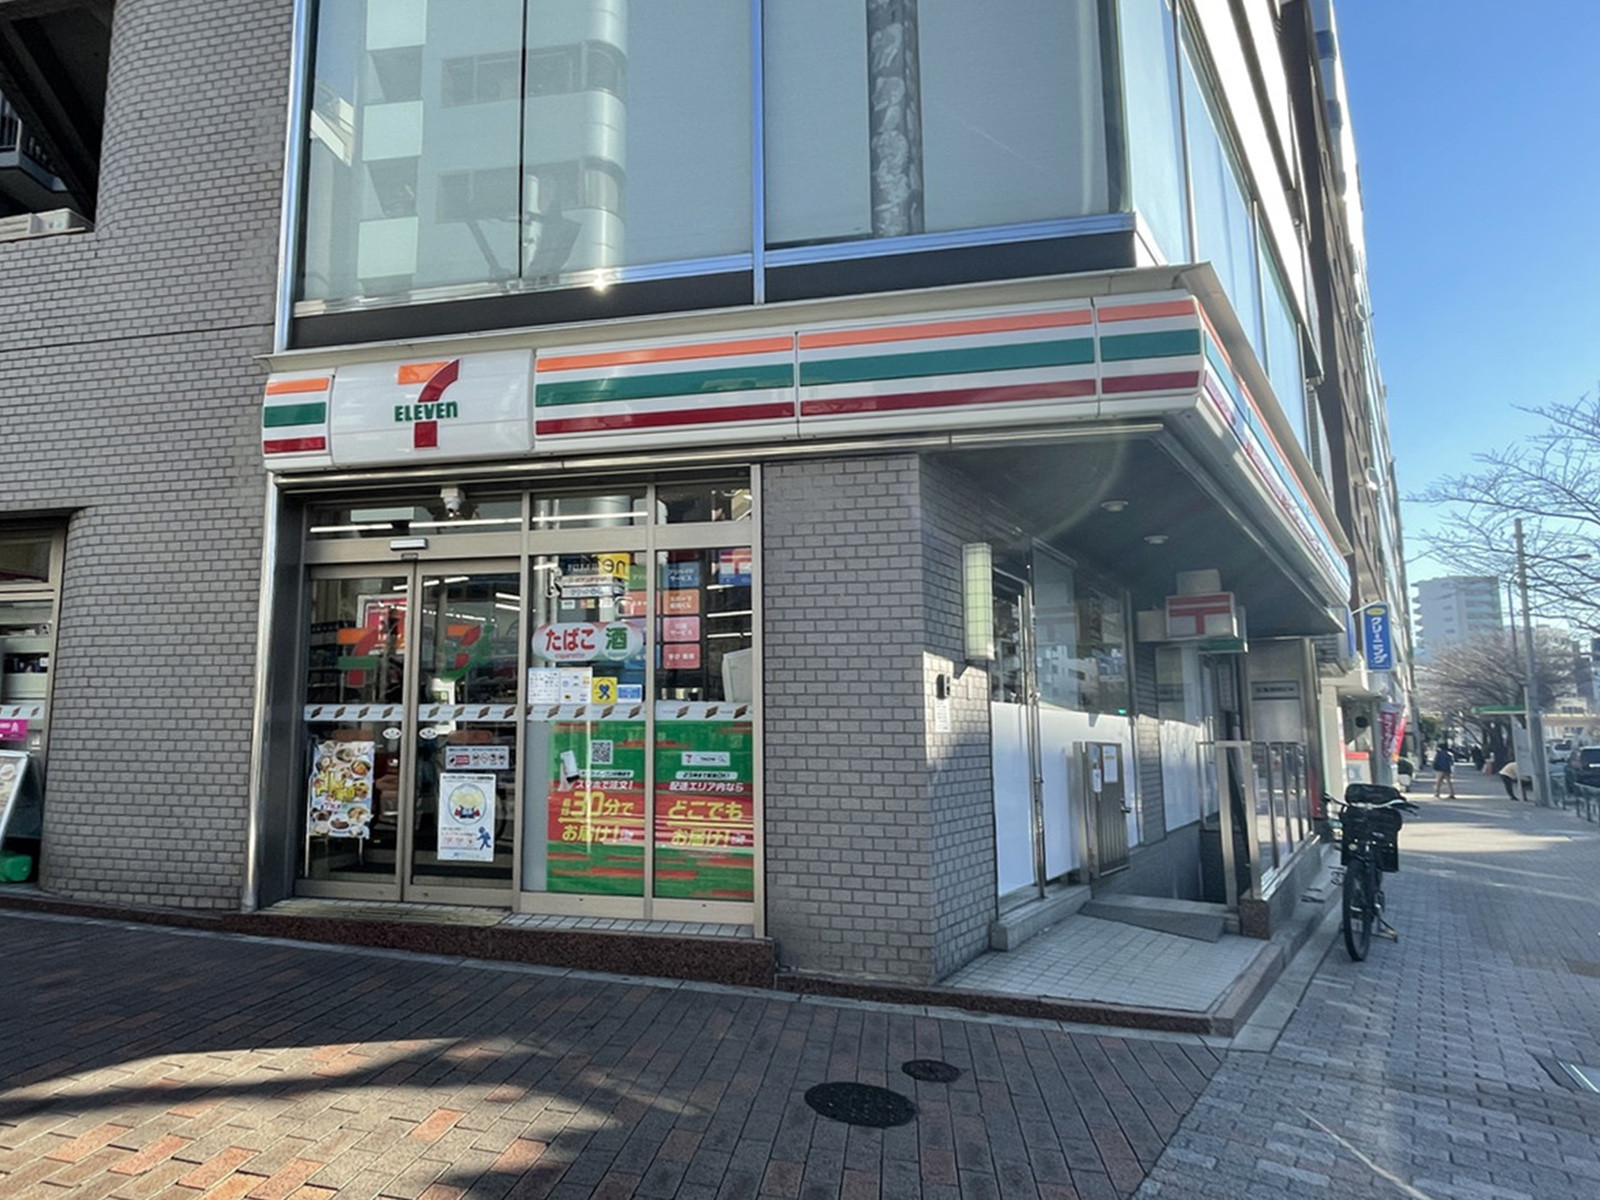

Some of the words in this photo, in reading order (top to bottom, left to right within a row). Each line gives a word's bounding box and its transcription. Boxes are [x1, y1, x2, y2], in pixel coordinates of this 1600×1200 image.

[546, 627, 595, 651] たばこ
[605, 626, 628, 650] 酒
[1371, 616, 1388, 664] クリーニング
[668, 800, 743, 821] どこでも
